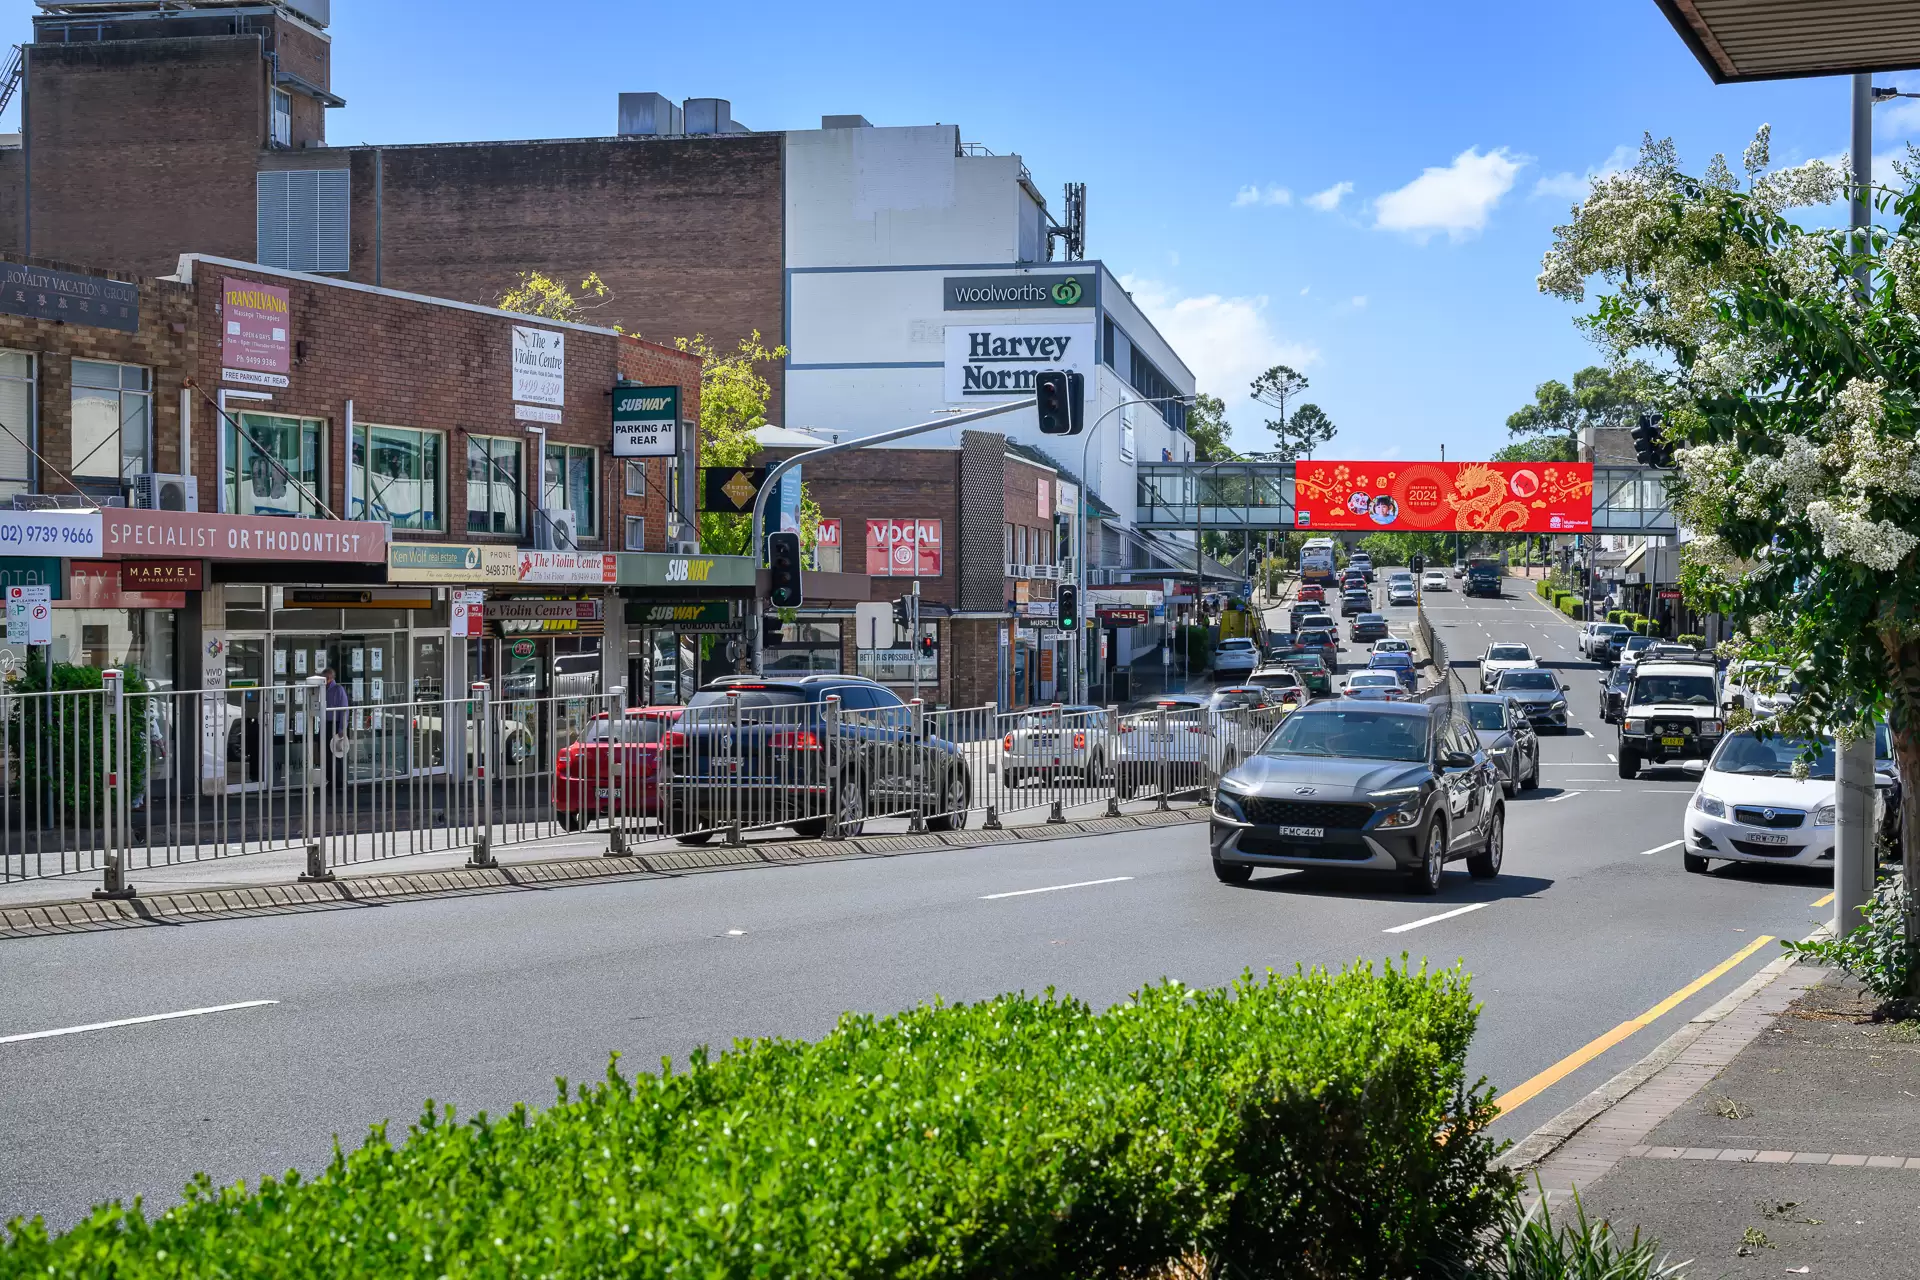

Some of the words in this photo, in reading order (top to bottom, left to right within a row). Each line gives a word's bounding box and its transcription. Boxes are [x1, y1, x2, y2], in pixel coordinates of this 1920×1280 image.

[7, 270, 49, 288] ROYALTY
[52, 277, 100, 297] VACATION
[104, 286, 135, 303] GROUP
[955, 283, 1047, 302] Woolworths
[226, 290, 288, 313] TRANSILVANIA
[233, 309, 254, 320] Massage
[256, 312, 280, 322] Therapies
[259, 333, 271, 341] DAYS
[532, 332, 546, 349] The
[968, 332, 1072, 361] Harvey
[236, 355, 245, 363] Ph
[245, 355, 262, 366] 9499
[262, 357, 277, 367] 9386
[514, 347, 537, 366] Violin
[538, 351, 562, 370] Centre
[225, 371, 239, 380] FREE
[239, 373, 262, 383] PARKING
[272, 377, 287, 386] REAR
[962, 365, 1075, 389] Norm
[518, 379, 539, 393] 9499
[617, 396, 672, 412] SUBWAY
[516, 406, 537, 420] Parking
[538, 409, 545, 419] at
[545, 412, 557, 421] rear
[615, 424, 658, 434] PARKING
[660, 423, 673, 433] AT
[630, 435, 658, 445] REAR
[1409, 490, 1437, 500] 2024
[26, 525, 58, 542] 9739
[62, 527, 93, 543] 9666
[110, 523, 217, 548] SPECIALIST
[228, 528, 360, 553] ORTHODONTIST
[873, 525, 940, 543] VOCAL
[393, 550, 408, 563] Ken
[409, 550, 427, 563] Wolf
[429, 551, 439, 562] real
[440, 551, 457, 563] estate
[490, 551, 511, 559] PHONE
[534, 553, 550, 568] The
[552, 553, 575, 569] Violin
[576, 554, 602, 569] Centre
[130, 567, 196, 577] MARVEL
[485, 564, 501, 576] 9498
[501, 565, 517, 576] 3716
[665, 559, 715, 582] SUBWAY
[500, 604, 532, 617] Violin
[535, 604, 573, 617] Centre
[646, 606, 706, 620] SUBWAY
[1111, 611, 1146, 622] Nails
[514, 643, 533, 654] OPEN
[859, 653, 881, 661] BETTR
[881, 653, 888, 661] IS
[205, 668, 222, 677] VIVID
[206, 678, 221, 686] NSW
